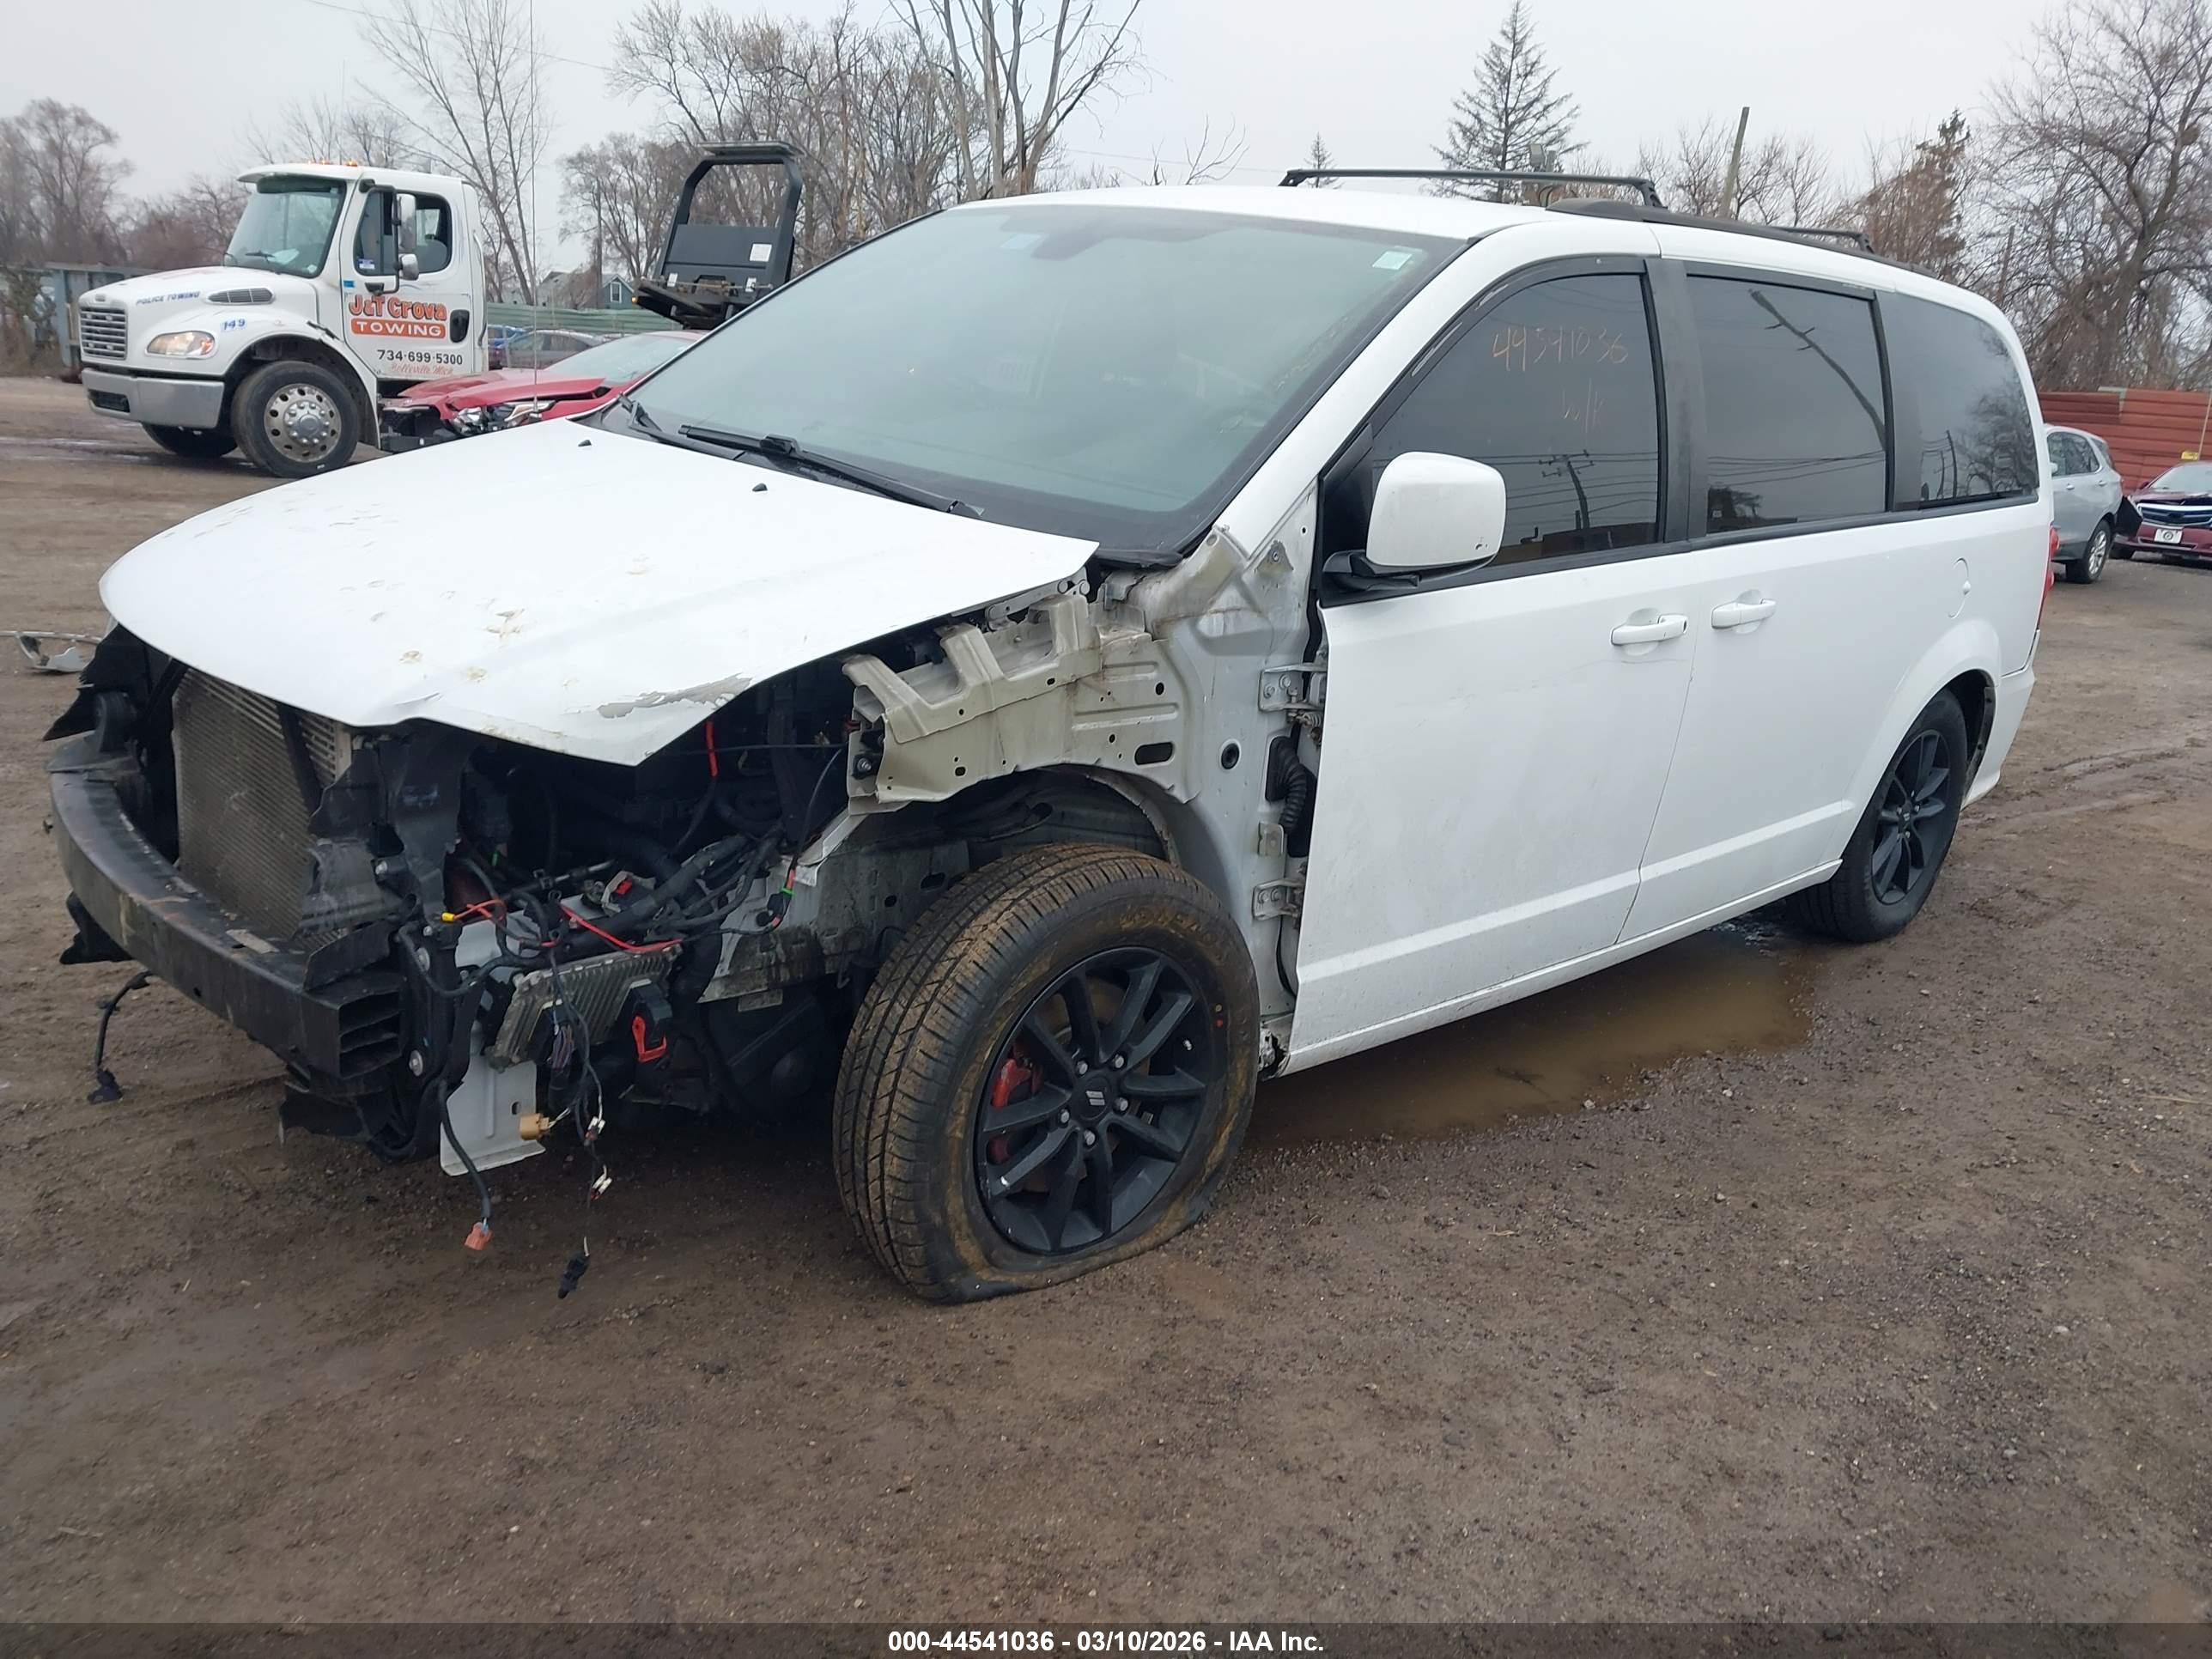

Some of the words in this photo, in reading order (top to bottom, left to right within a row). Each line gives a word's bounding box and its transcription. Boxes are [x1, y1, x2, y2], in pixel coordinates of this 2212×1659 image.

[136, 295, 165, 306] POLICE
[167, 290, 201, 301] TOWING
[348, 295, 386, 317] J&T
[387, 297, 447, 321] Crova
[222, 319, 246, 331] 149
[356, 321, 442, 337] TOWING
